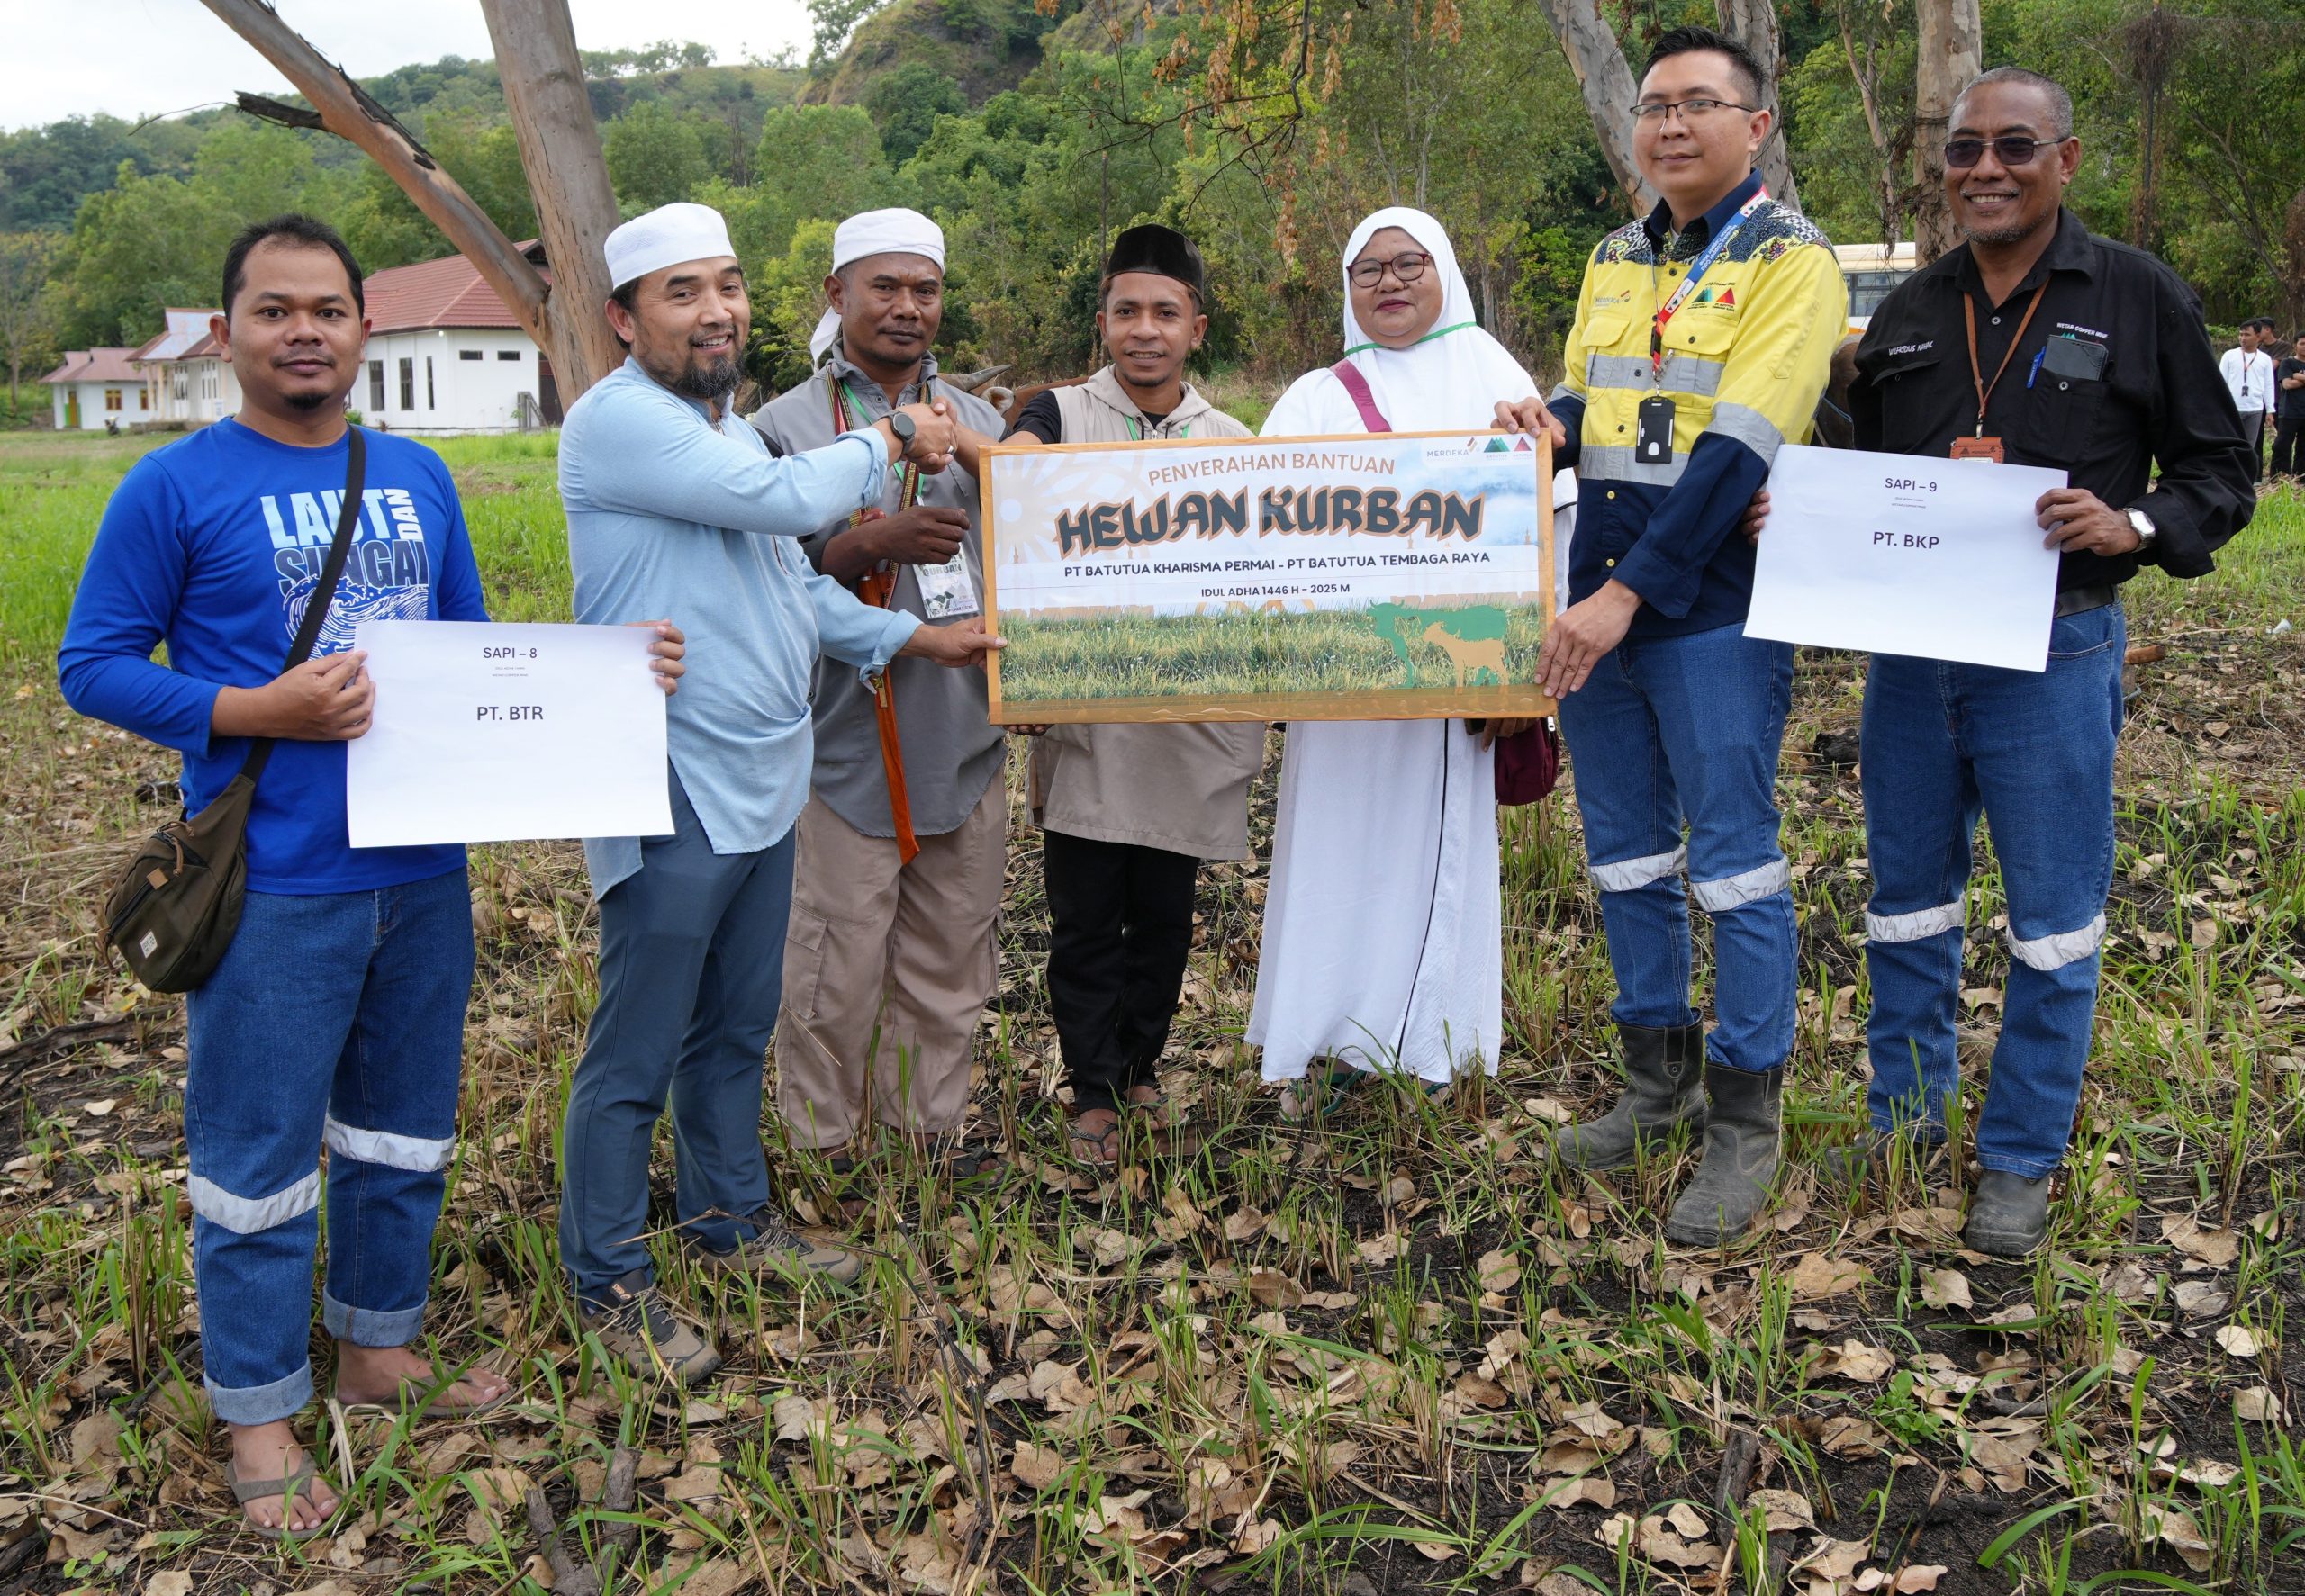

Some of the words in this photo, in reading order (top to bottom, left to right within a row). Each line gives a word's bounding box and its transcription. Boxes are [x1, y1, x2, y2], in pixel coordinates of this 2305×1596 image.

[2074, 326, 2095, 336] COPPER
[1426, 449, 1469, 457] MERDEKA
[1148, 453, 1286, 486] PENYERAHAN
[1292, 453, 1395, 475] BANTUAN
[1885, 477, 1915, 491] SAPI
[1929, 482, 1938, 492] 9
[260, 489, 391, 548] LAUT
[383, 489, 424, 540] DAN
[1053, 485, 1250, 561] HEWAN
[1258, 484, 1486, 543] KURBAN
[1873, 531, 1897, 546] PT.
[1903, 534, 1940, 549] BKP
[1064, 566, 1082, 577] PT
[1085, 564, 1151, 577] BATUTUA
[1153, 561, 1222, 574] KHARISMA
[1225, 559, 1275, 572] PERMAI
[1287, 558, 1306, 570] PT
[1308, 555, 1377, 569] BATUTUA
[1379, 553, 1449, 567] TEMBAGA
[1452, 552, 1491, 564] RAYA
[1201, 588, 1225, 598] IDUL
[1228, 586, 1261, 597] ADHA
[1262, 585, 1288, 596] 1446
[1291, 585, 1299, 595] H
[1310, 583, 1338, 594] 2025
[1340, 583, 1351, 593] M
[483, 646, 515, 659] SAPI
[529, 647, 538, 659] 8
[476, 706, 502, 721] PT.
[509, 706, 544, 721] BTR
